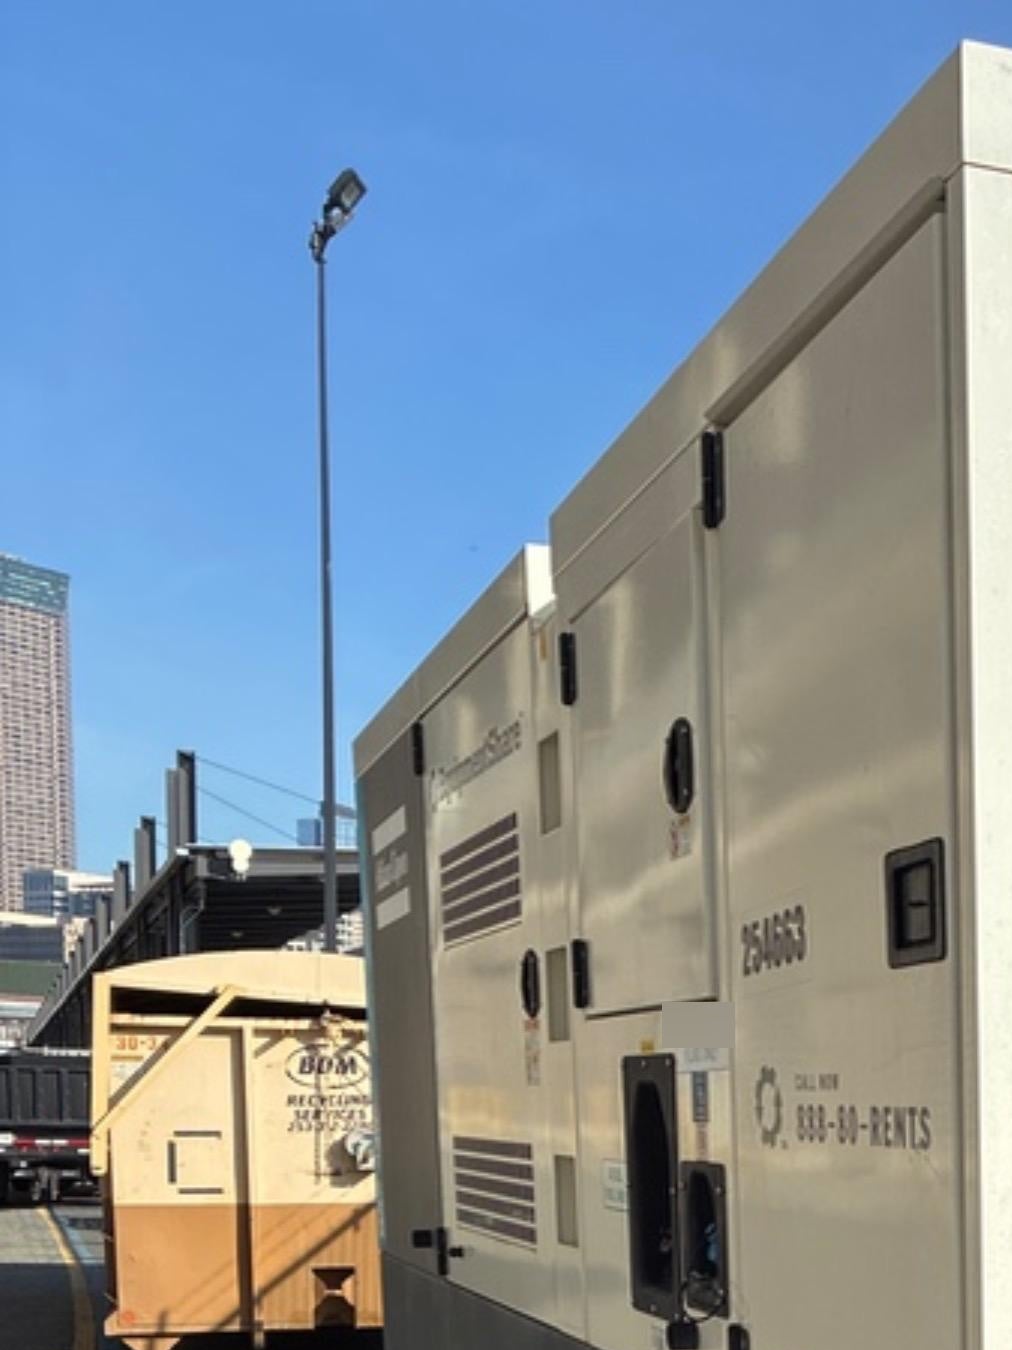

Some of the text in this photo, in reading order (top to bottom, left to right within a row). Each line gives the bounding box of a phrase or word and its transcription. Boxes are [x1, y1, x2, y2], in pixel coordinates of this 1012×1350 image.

[741, 904, 806, 977] 254663
[298, 1055, 358, 1076] BDM
[796, 1103, 932, 1151] 888-80-RENTS
